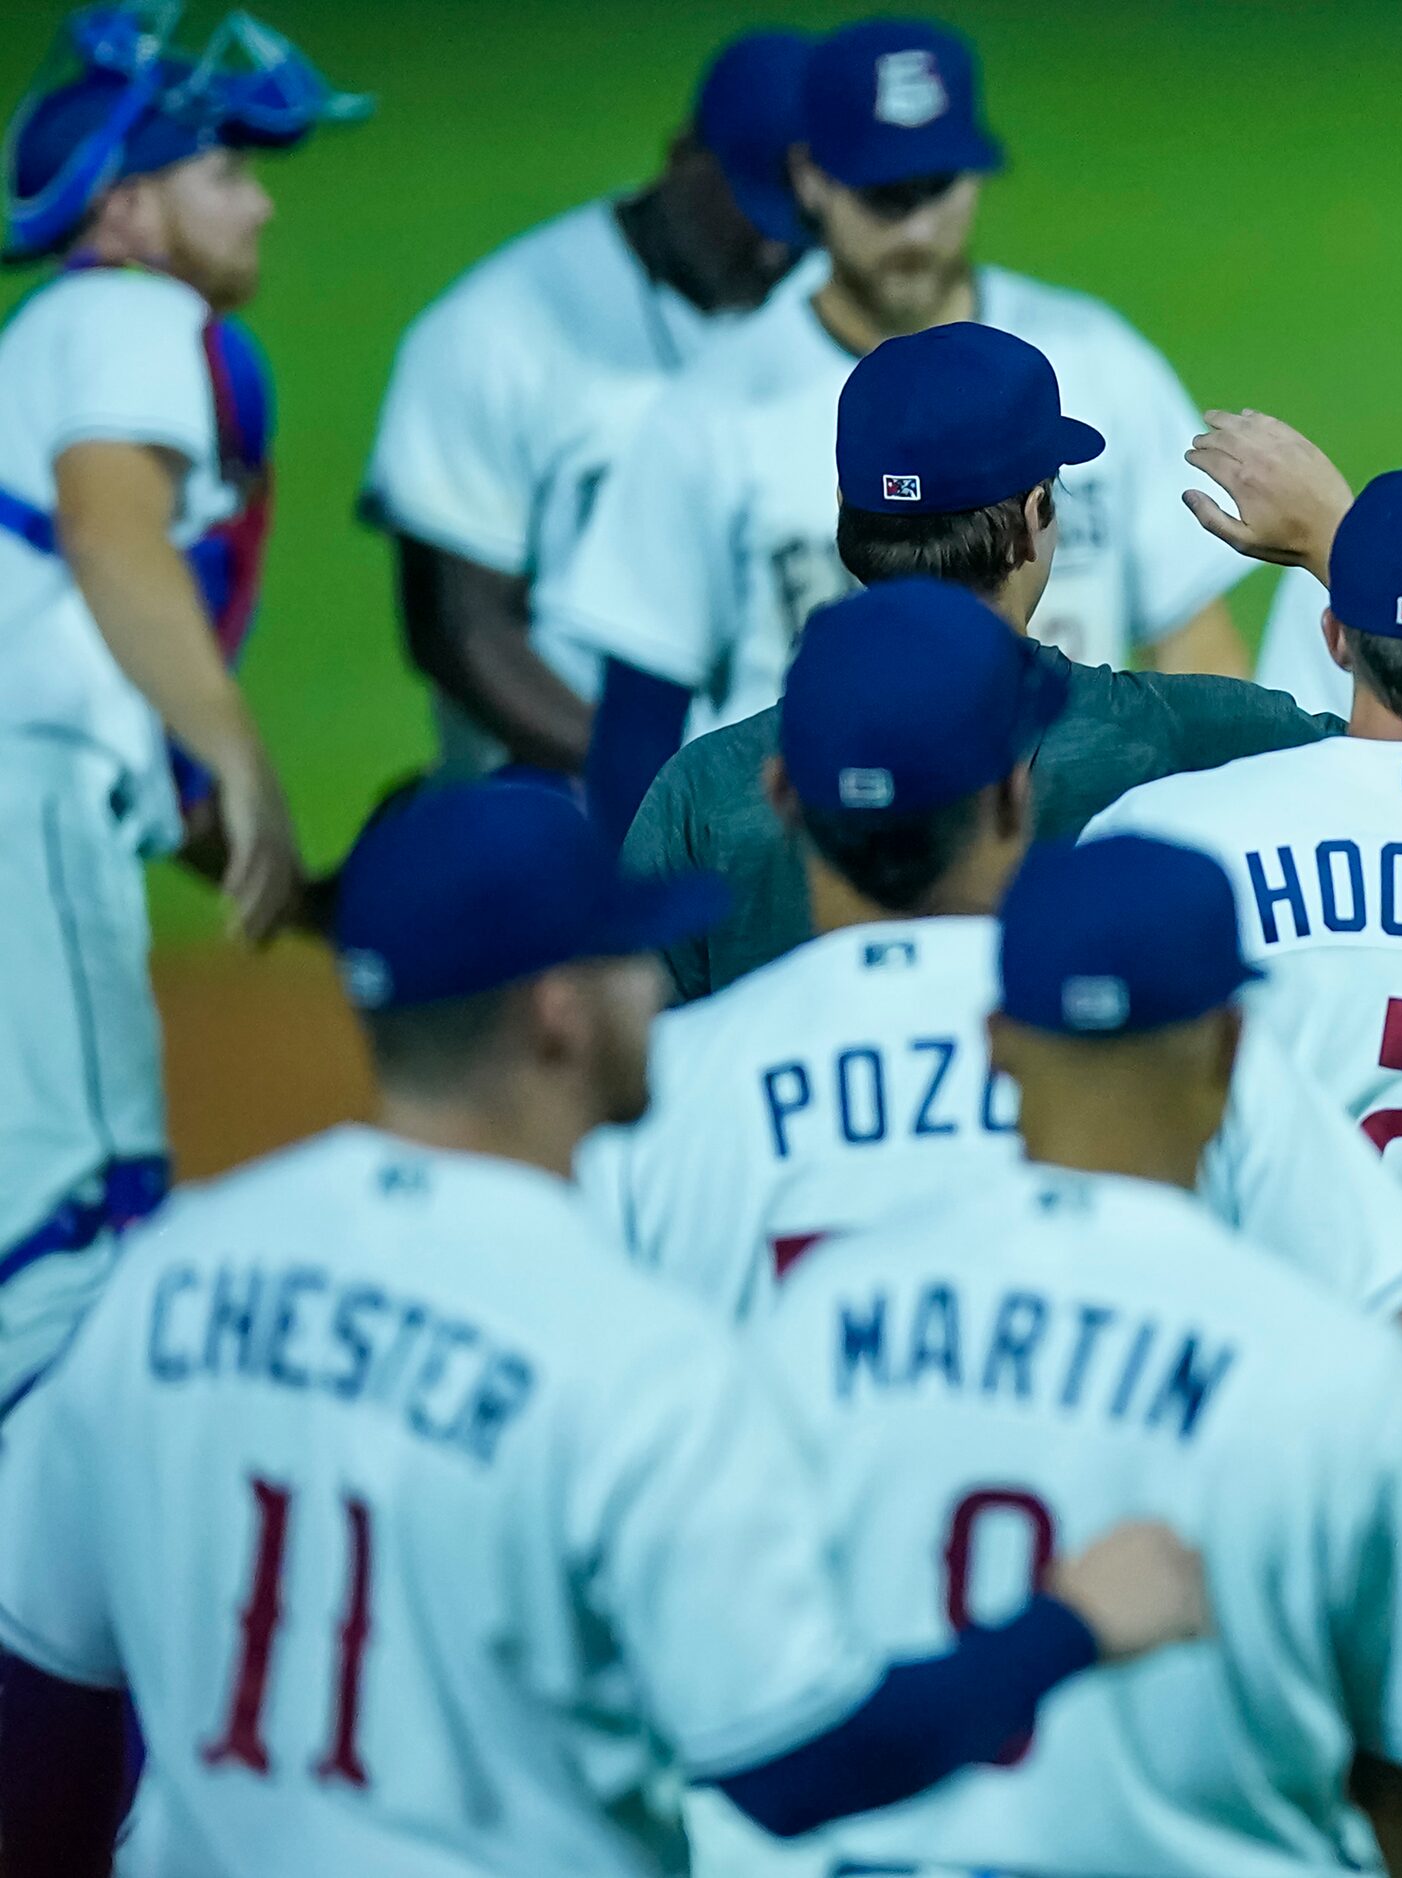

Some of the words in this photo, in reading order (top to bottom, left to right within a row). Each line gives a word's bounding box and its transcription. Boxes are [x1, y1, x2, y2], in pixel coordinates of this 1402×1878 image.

[150, 1262, 534, 1465] CHESTER
[836, 1275, 1237, 1446] MARTIN
[202, 1475, 376, 1788] 11
